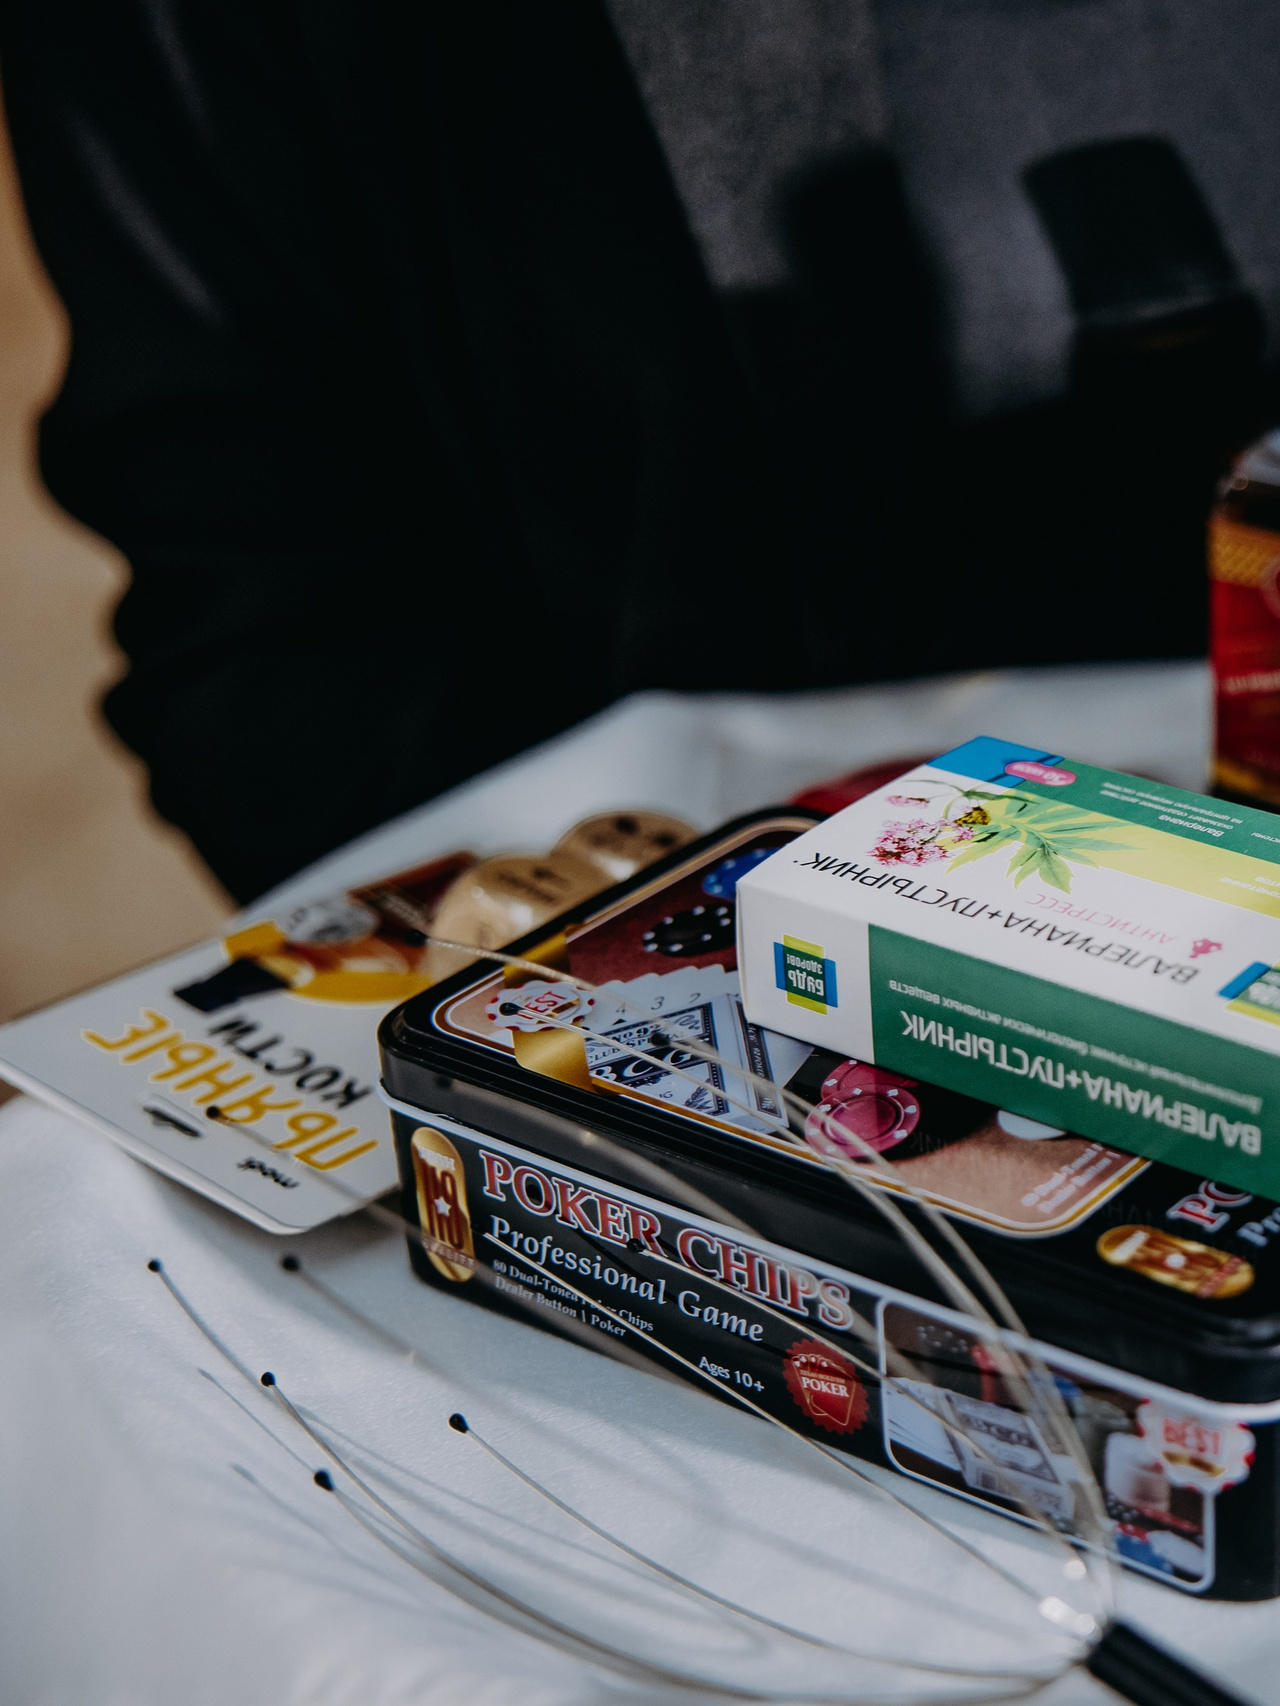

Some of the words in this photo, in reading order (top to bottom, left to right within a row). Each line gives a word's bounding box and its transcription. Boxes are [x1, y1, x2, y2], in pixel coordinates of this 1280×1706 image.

[1156, 812, 1225, 837] Валериана
[1024, 891, 1178, 948] АНТИСТРЕСС
[785, 952, 822, 975] ЗДОРОВ!
[786, 966, 824, 996] БУДЬ
[889, 978, 939, 1005] веществ
[942, 996, 1001, 1026] активных
[207, 1015, 372, 1110] КОСТИ
[82, 1007, 379, 1171] ПЬЯНЫЕ
[899, 1008, 1266, 1157] ВАЛЕРИАНА+ПУСТЫРНИК
[480, 1149, 667, 1258] POKER
[677, 1227, 853, 1331] CHIPS
[490, 1214, 667, 1306] Professional
[678, 1291, 765, 1341] Game
[494, 1276, 534, 1300] Dealer
[536, 1293, 577, 1317] Button
[591, 1314, 627, 1337] Poker
[698, 1355, 732, 1380] Ages
[734, 1368, 765, 1394] 10+
[800, 1375, 849, 1397] POKER
[1162, 1417, 1222, 1455] BEST
